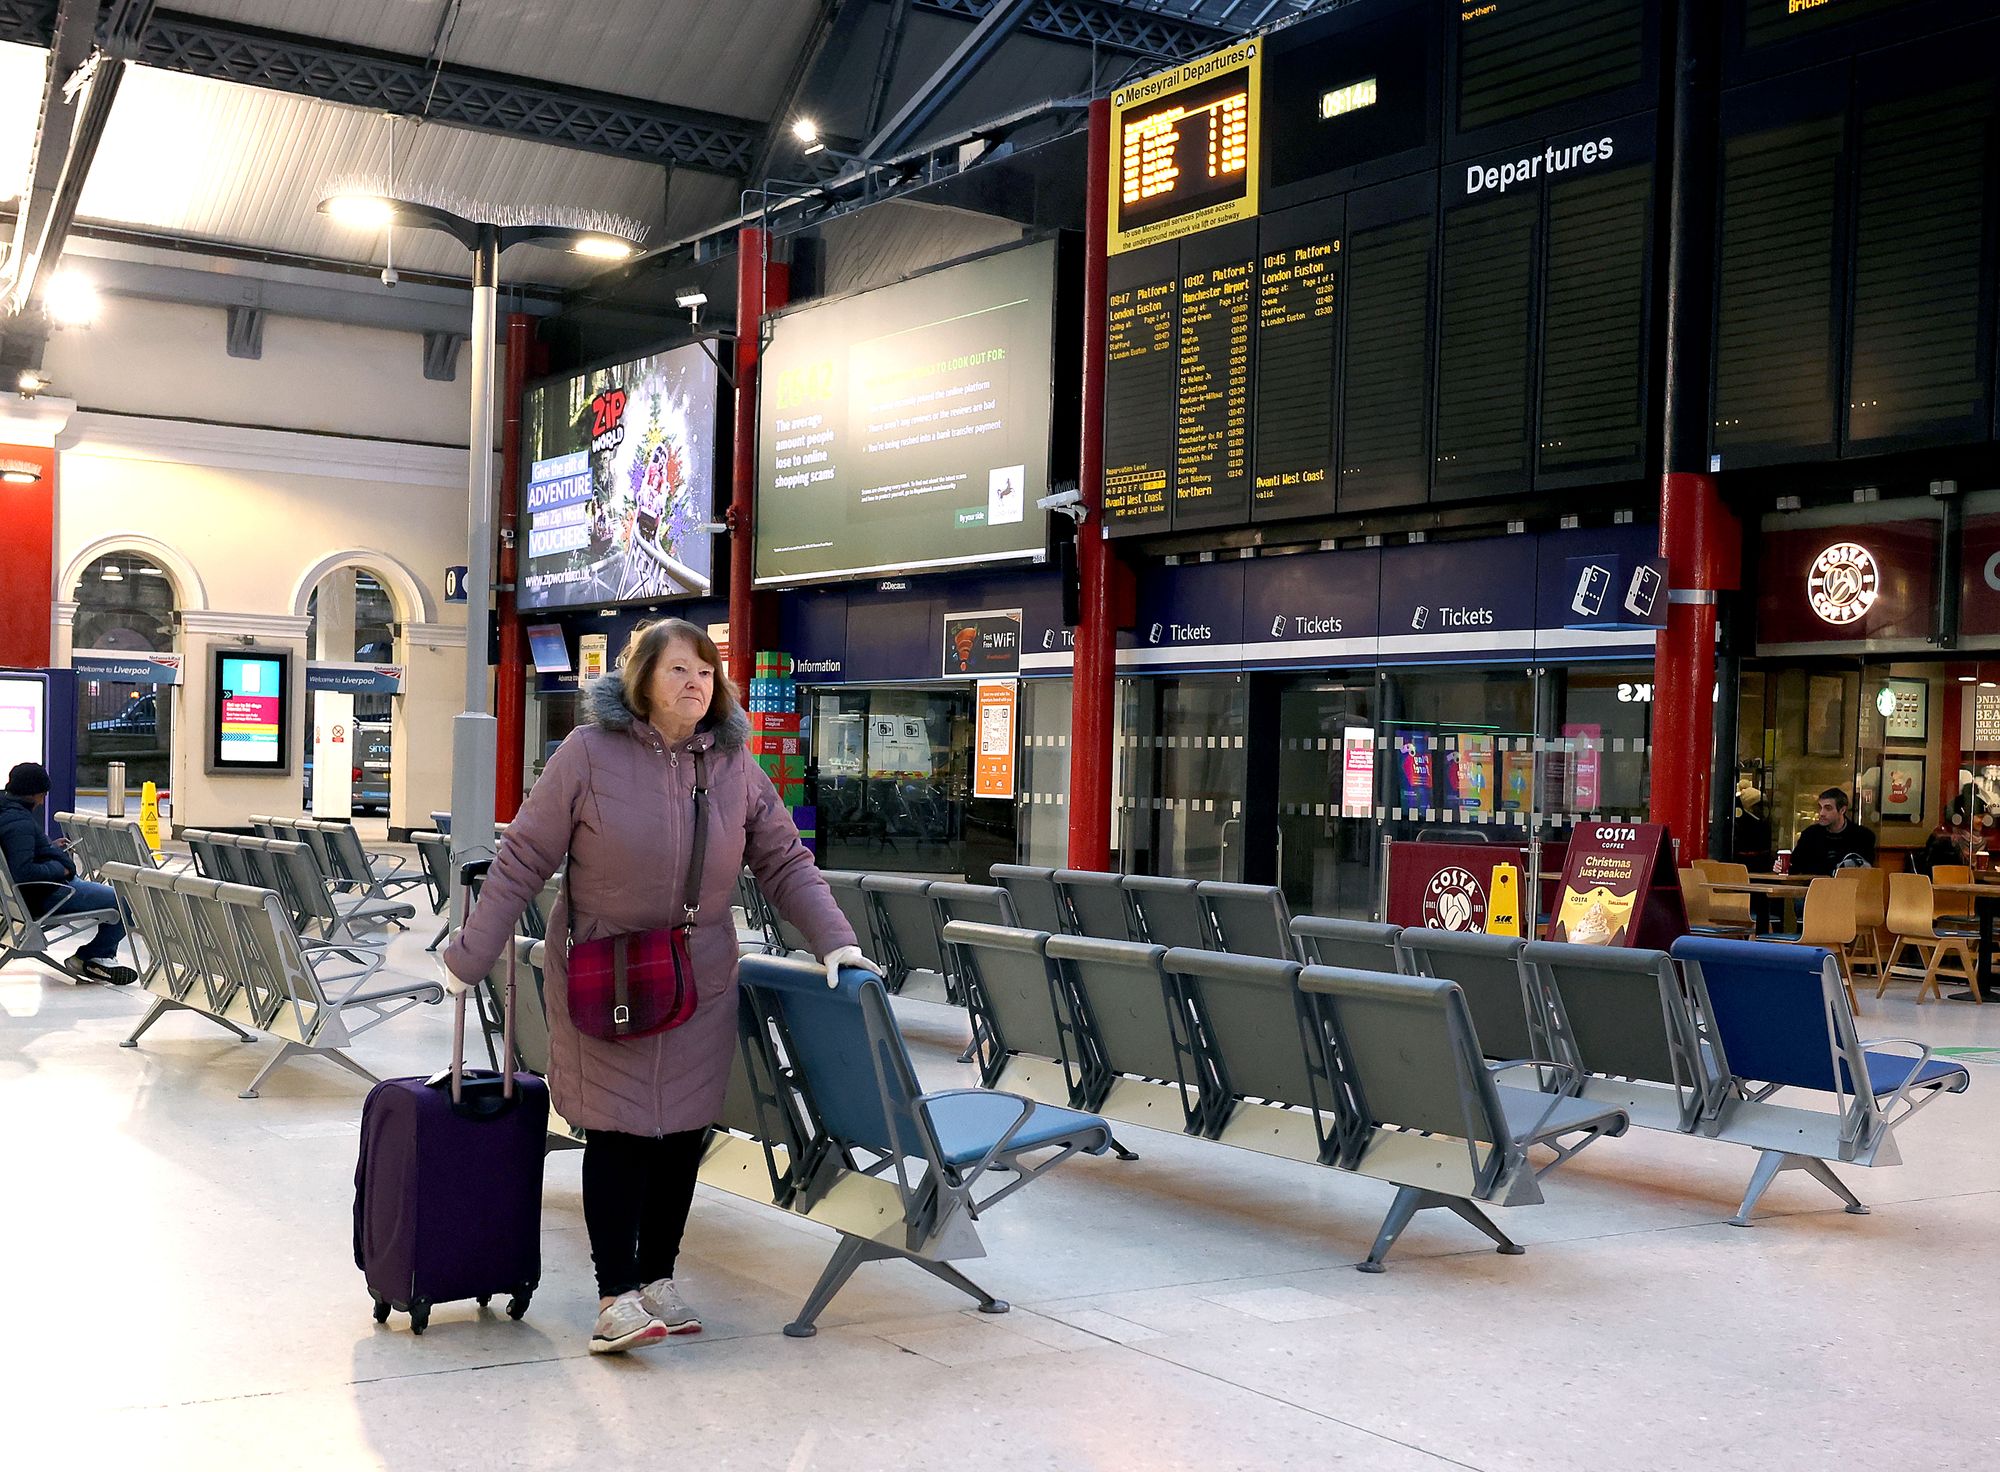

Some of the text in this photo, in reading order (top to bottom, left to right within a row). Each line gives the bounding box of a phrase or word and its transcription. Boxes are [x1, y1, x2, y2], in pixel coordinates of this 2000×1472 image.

[1462, 3, 1497, 21] Northern
[1126, 49, 1245, 103] Merseyrail Departures
[1466, 136, 1614, 195] Departures
[1132, 228, 1141, 236] use
[1142, 219, 1170, 234] Merseyrail
[1172, 214, 1194, 226] services
[1196, 208, 1214, 220] please
[1215, 202, 1236, 212] access
[1122, 241, 1132, 250] the
[1132, 232, 1168, 247] underground
[1168, 226, 1190, 237] network
[1201, 220, 1210, 228] lift
[1217, 212, 1240, 223] subway
[1264, 240, 1340, 268] 10:45 Platform 9
[1184, 262, 1254, 288] 10:02 Platform 5
[1262, 262, 1324, 284] London Euston
[1302, 278, 1316, 287] Page
[1322, 274, 1329, 282] of
[1110, 282, 1176, 307] 09:47 Platform 9
[1182, 279, 1249, 304] Manchester Airport
[1262, 286, 1280, 296] Calling
[1262, 298, 1278, 306] Crewe
[1262, 305, 1286, 317] Stafford
[1110, 302, 1162, 321] London Euston
[1266, 316, 1286, 327] London
[1287, 312, 1306, 322] Euston
[948, 357, 968, 371] LOOK
[970, 352, 986, 366] OUT
[988, 348, 1006, 362] FOR:
[964, 380, 990, 396] platform
[950, 404, 972, 417] reviews
[972, 404, 983, 413] are
[984, 399, 996, 410] bad
[776, 414, 822, 432] The average
[592, 425, 624, 452] WORLD
[776, 427, 834, 451] amount people
[885, 438, 900, 450] being
[936, 428, 950, 440] bank
[952, 424, 975, 438] transfer
[975, 420, 1002, 435] payment
[776, 449, 828, 470] lose to online
[534, 464, 551, 480] Give
[552, 461, 564, 476] the
[564, 458, 578, 476] gift
[1256, 468, 1324, 488] Avanti West Coast
[775, 471, 810, 489] shopping
[528, 474, 592, 508] ADVENTURE
[1106, 491, 1162, 508] Avanti West Coast
[1178, 486, 1212, 498] Northern
[534, 511, 550, 527] with
[550, 510, 562, 527] Zip
[530, 527, 588, 553] VOUCHERS
[1818, 546, 1868, 572] COSTA
[880, 580, 906, 590] JCDecaux
[1296, 615, 1342, 634] Tickets
[1440, 606, 1493, 628] Tickets
[994, 632, 1016, 648] WiFi
[1061, 630, 1075, 646] Tic
[1170, 624, 1212, 641] Tickets
[114, 666, 150, 676] Liverpool
[798, 659, 840, 674] Information
[310, 676, 334, 684] Welcome
[342, 676, 376, 686] Liverpool
[1976, 710, 2000, 720] BEA
[369, 744, 392, 753] simo
[1596, 828, 1636, 841] COSTA
[1586, 856, 1632, 868] Christmas
[1578, 866, 1632, 879] just peaked
[1432, 870, 1470, 898] COSTA
